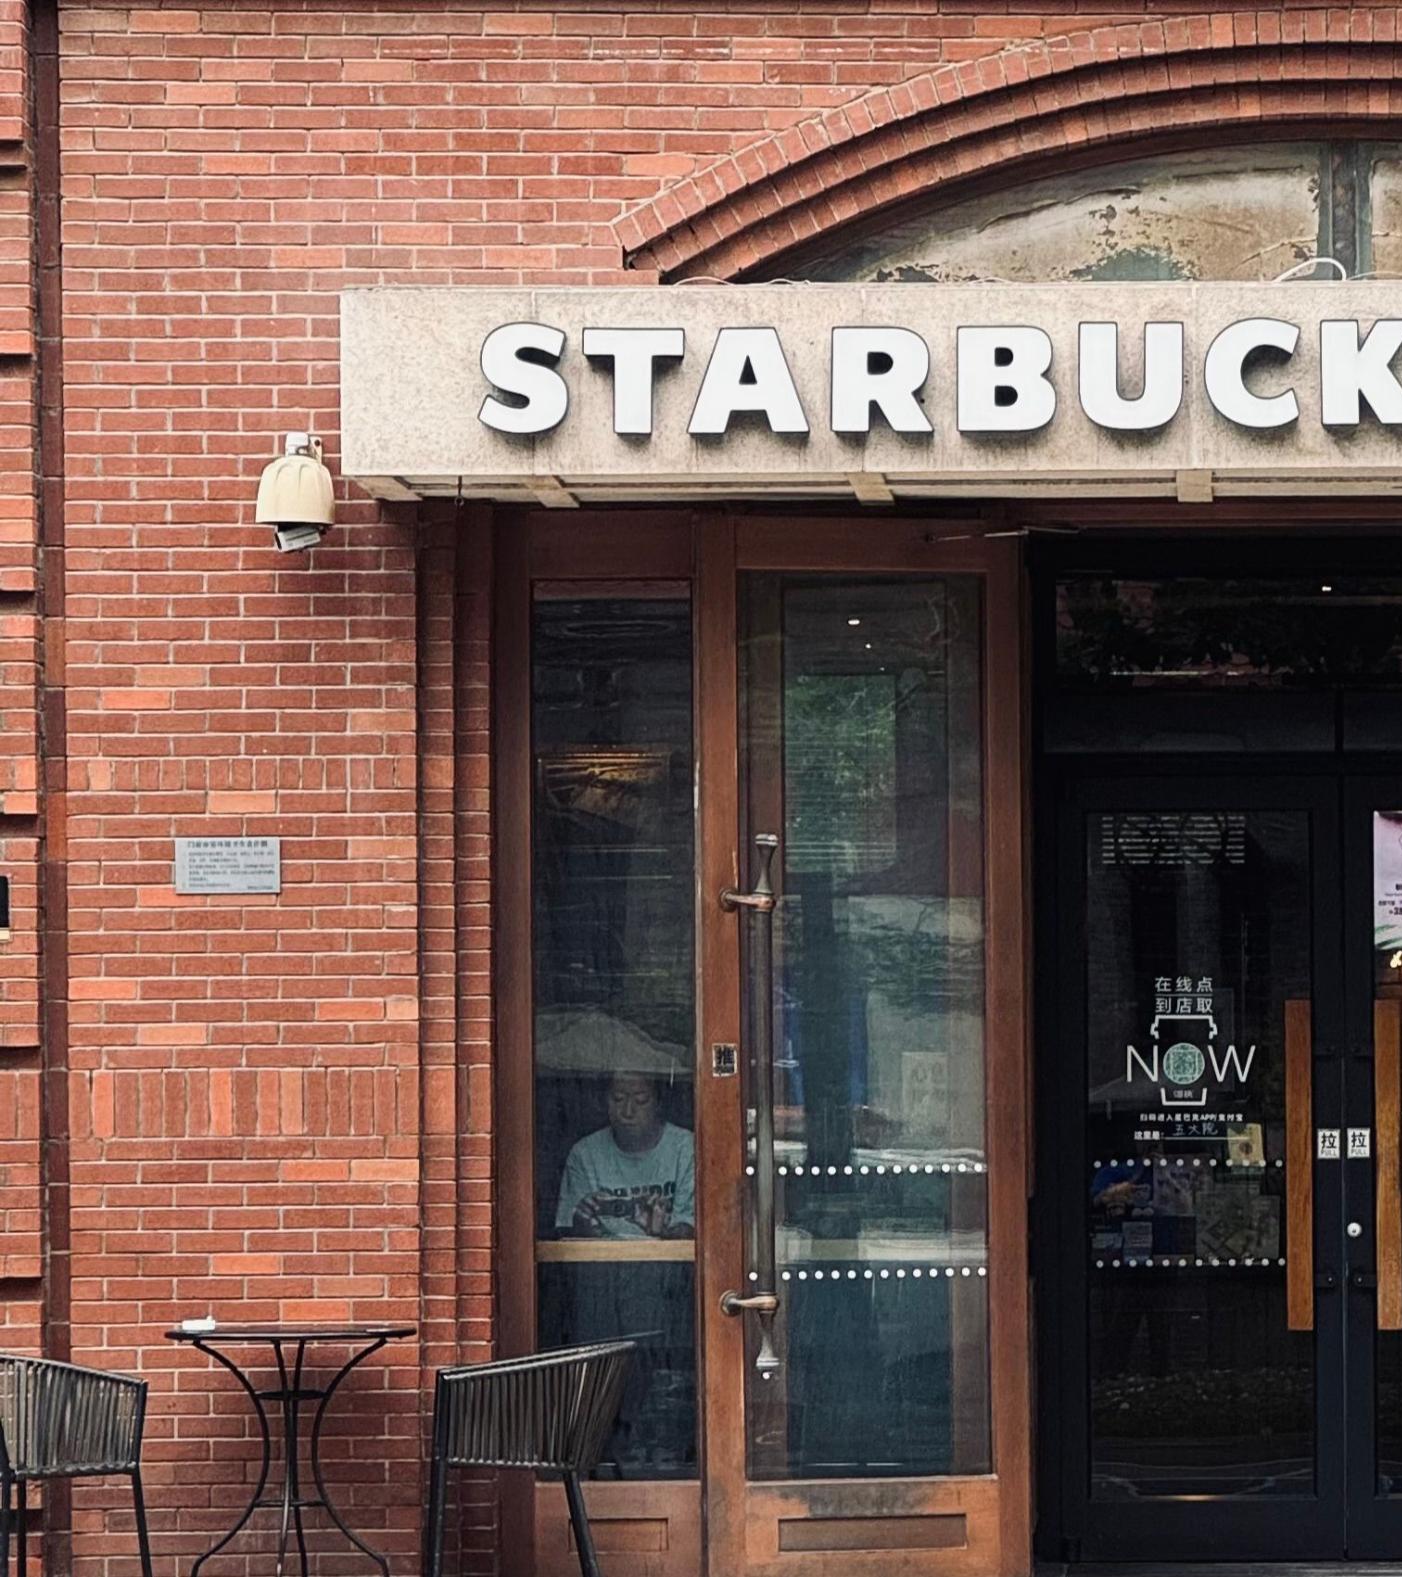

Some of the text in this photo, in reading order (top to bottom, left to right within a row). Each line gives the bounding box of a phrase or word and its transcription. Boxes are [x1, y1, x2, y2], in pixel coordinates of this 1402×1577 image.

[1154, 976, 1214, 993] 在线点
[1154, 997, 1214, 1014] 到店取
[1321, 1132, 1337, 1149] 拉
[1351, 1131, 1367, 1148] 拉
